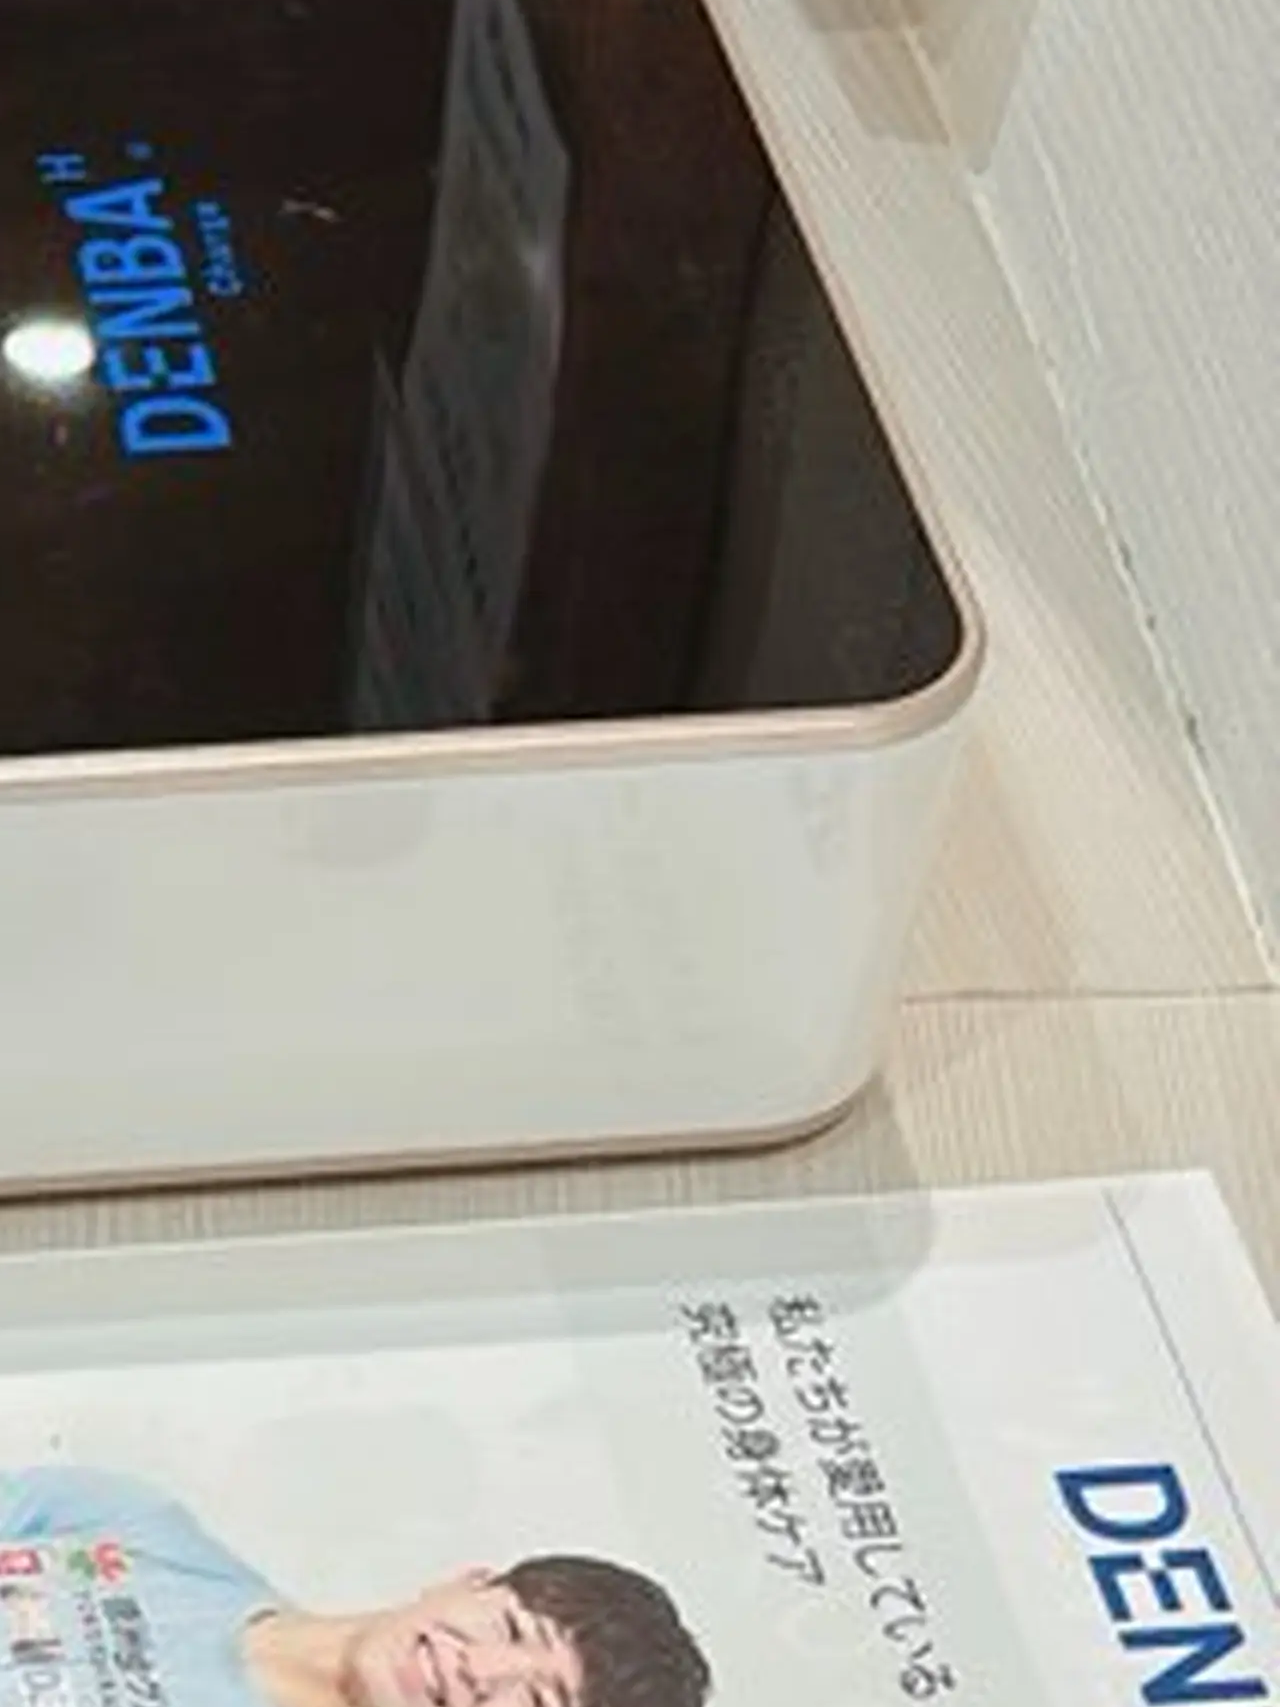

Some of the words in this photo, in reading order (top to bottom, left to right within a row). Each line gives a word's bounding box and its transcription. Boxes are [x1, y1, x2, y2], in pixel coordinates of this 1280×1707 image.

[64, 178, 231, 455] DENBA
[681, 1299, 825, 1587] 究極の身体ケア
[768, 1293, 956, 1701] 私たちが愛用している
